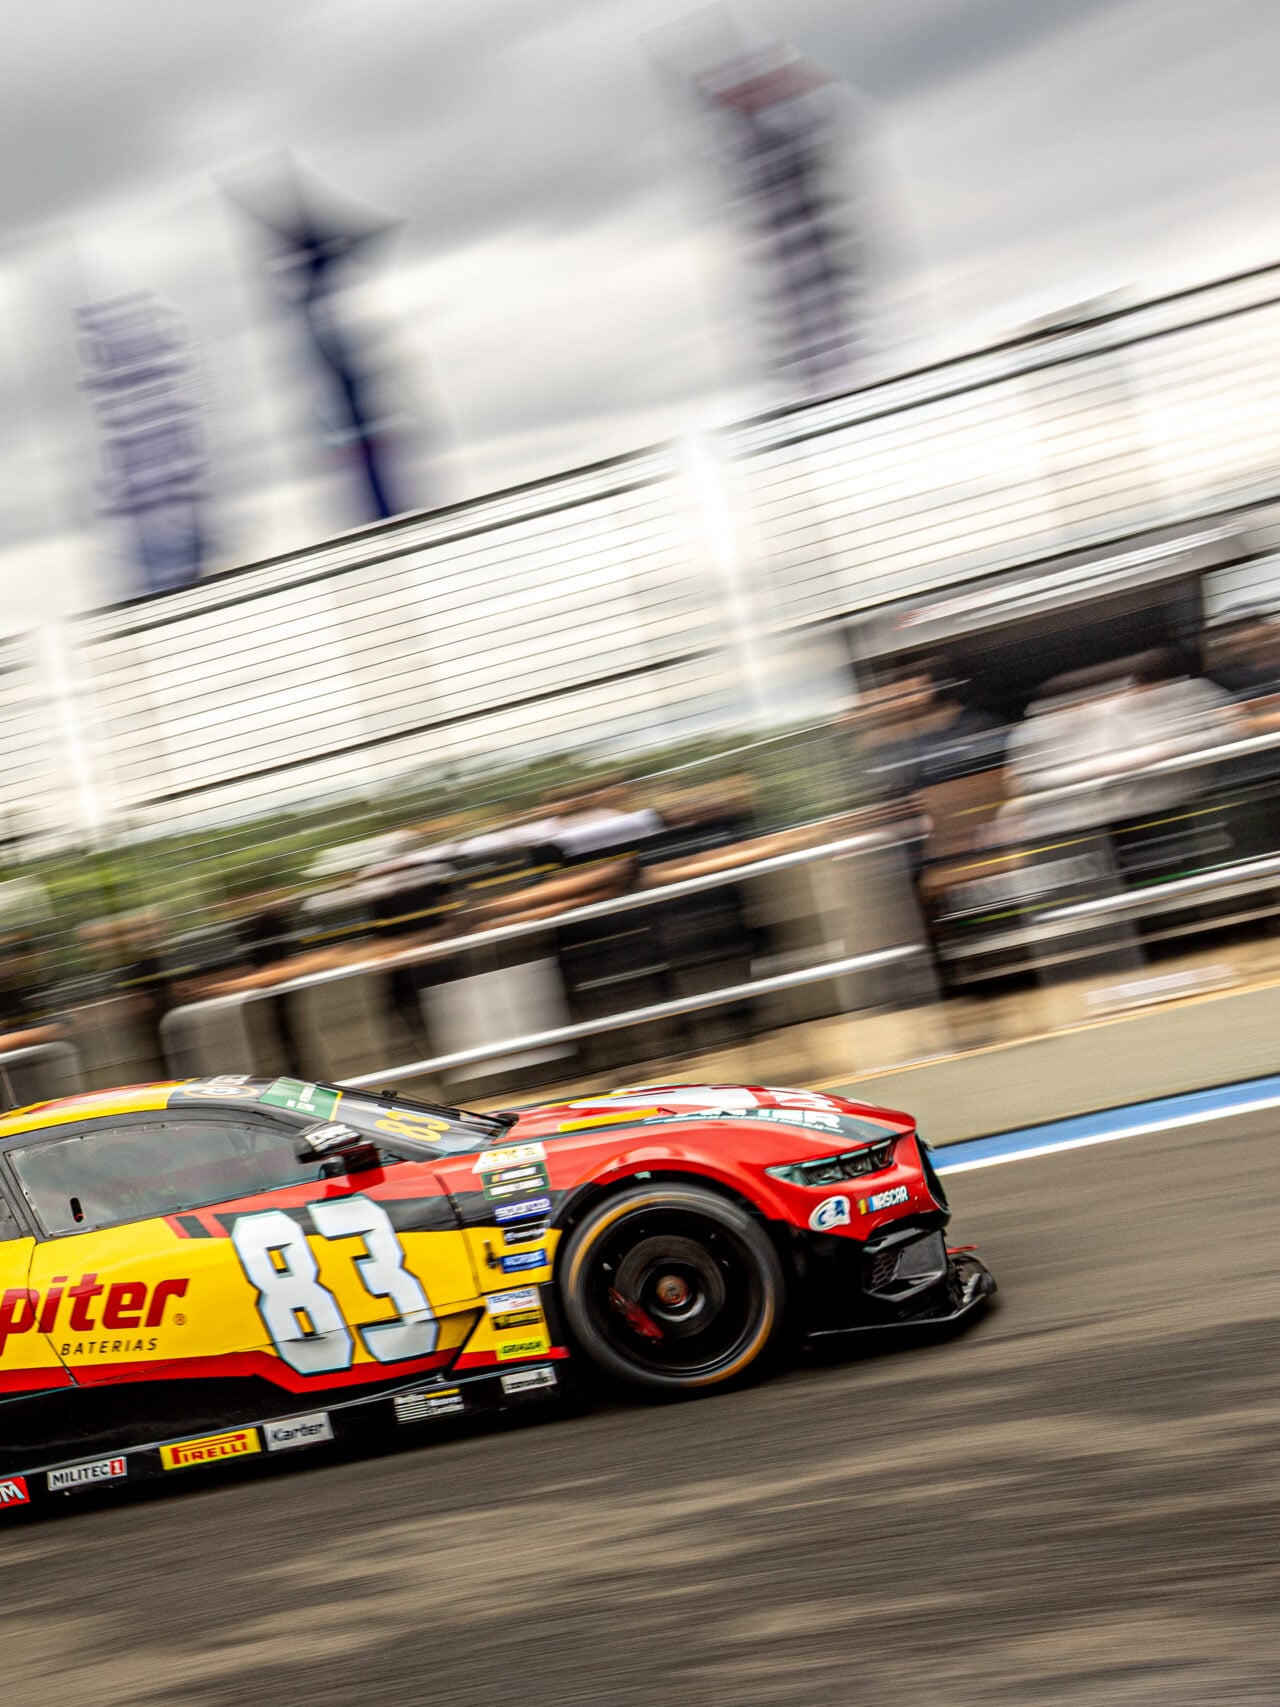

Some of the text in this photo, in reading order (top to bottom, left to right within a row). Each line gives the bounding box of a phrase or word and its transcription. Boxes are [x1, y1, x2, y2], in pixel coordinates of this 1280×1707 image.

[374, 1110, 450, 1142] 83
[873, 1185, 909, 1212] NASCAR
[231, 1193, 441, 1377] 83
[60, 1337, 159, 1357] BATERIAS
[272, 1422, 324, 1443] Karter
[170, 1433, 249, 1465] PIRELLI
